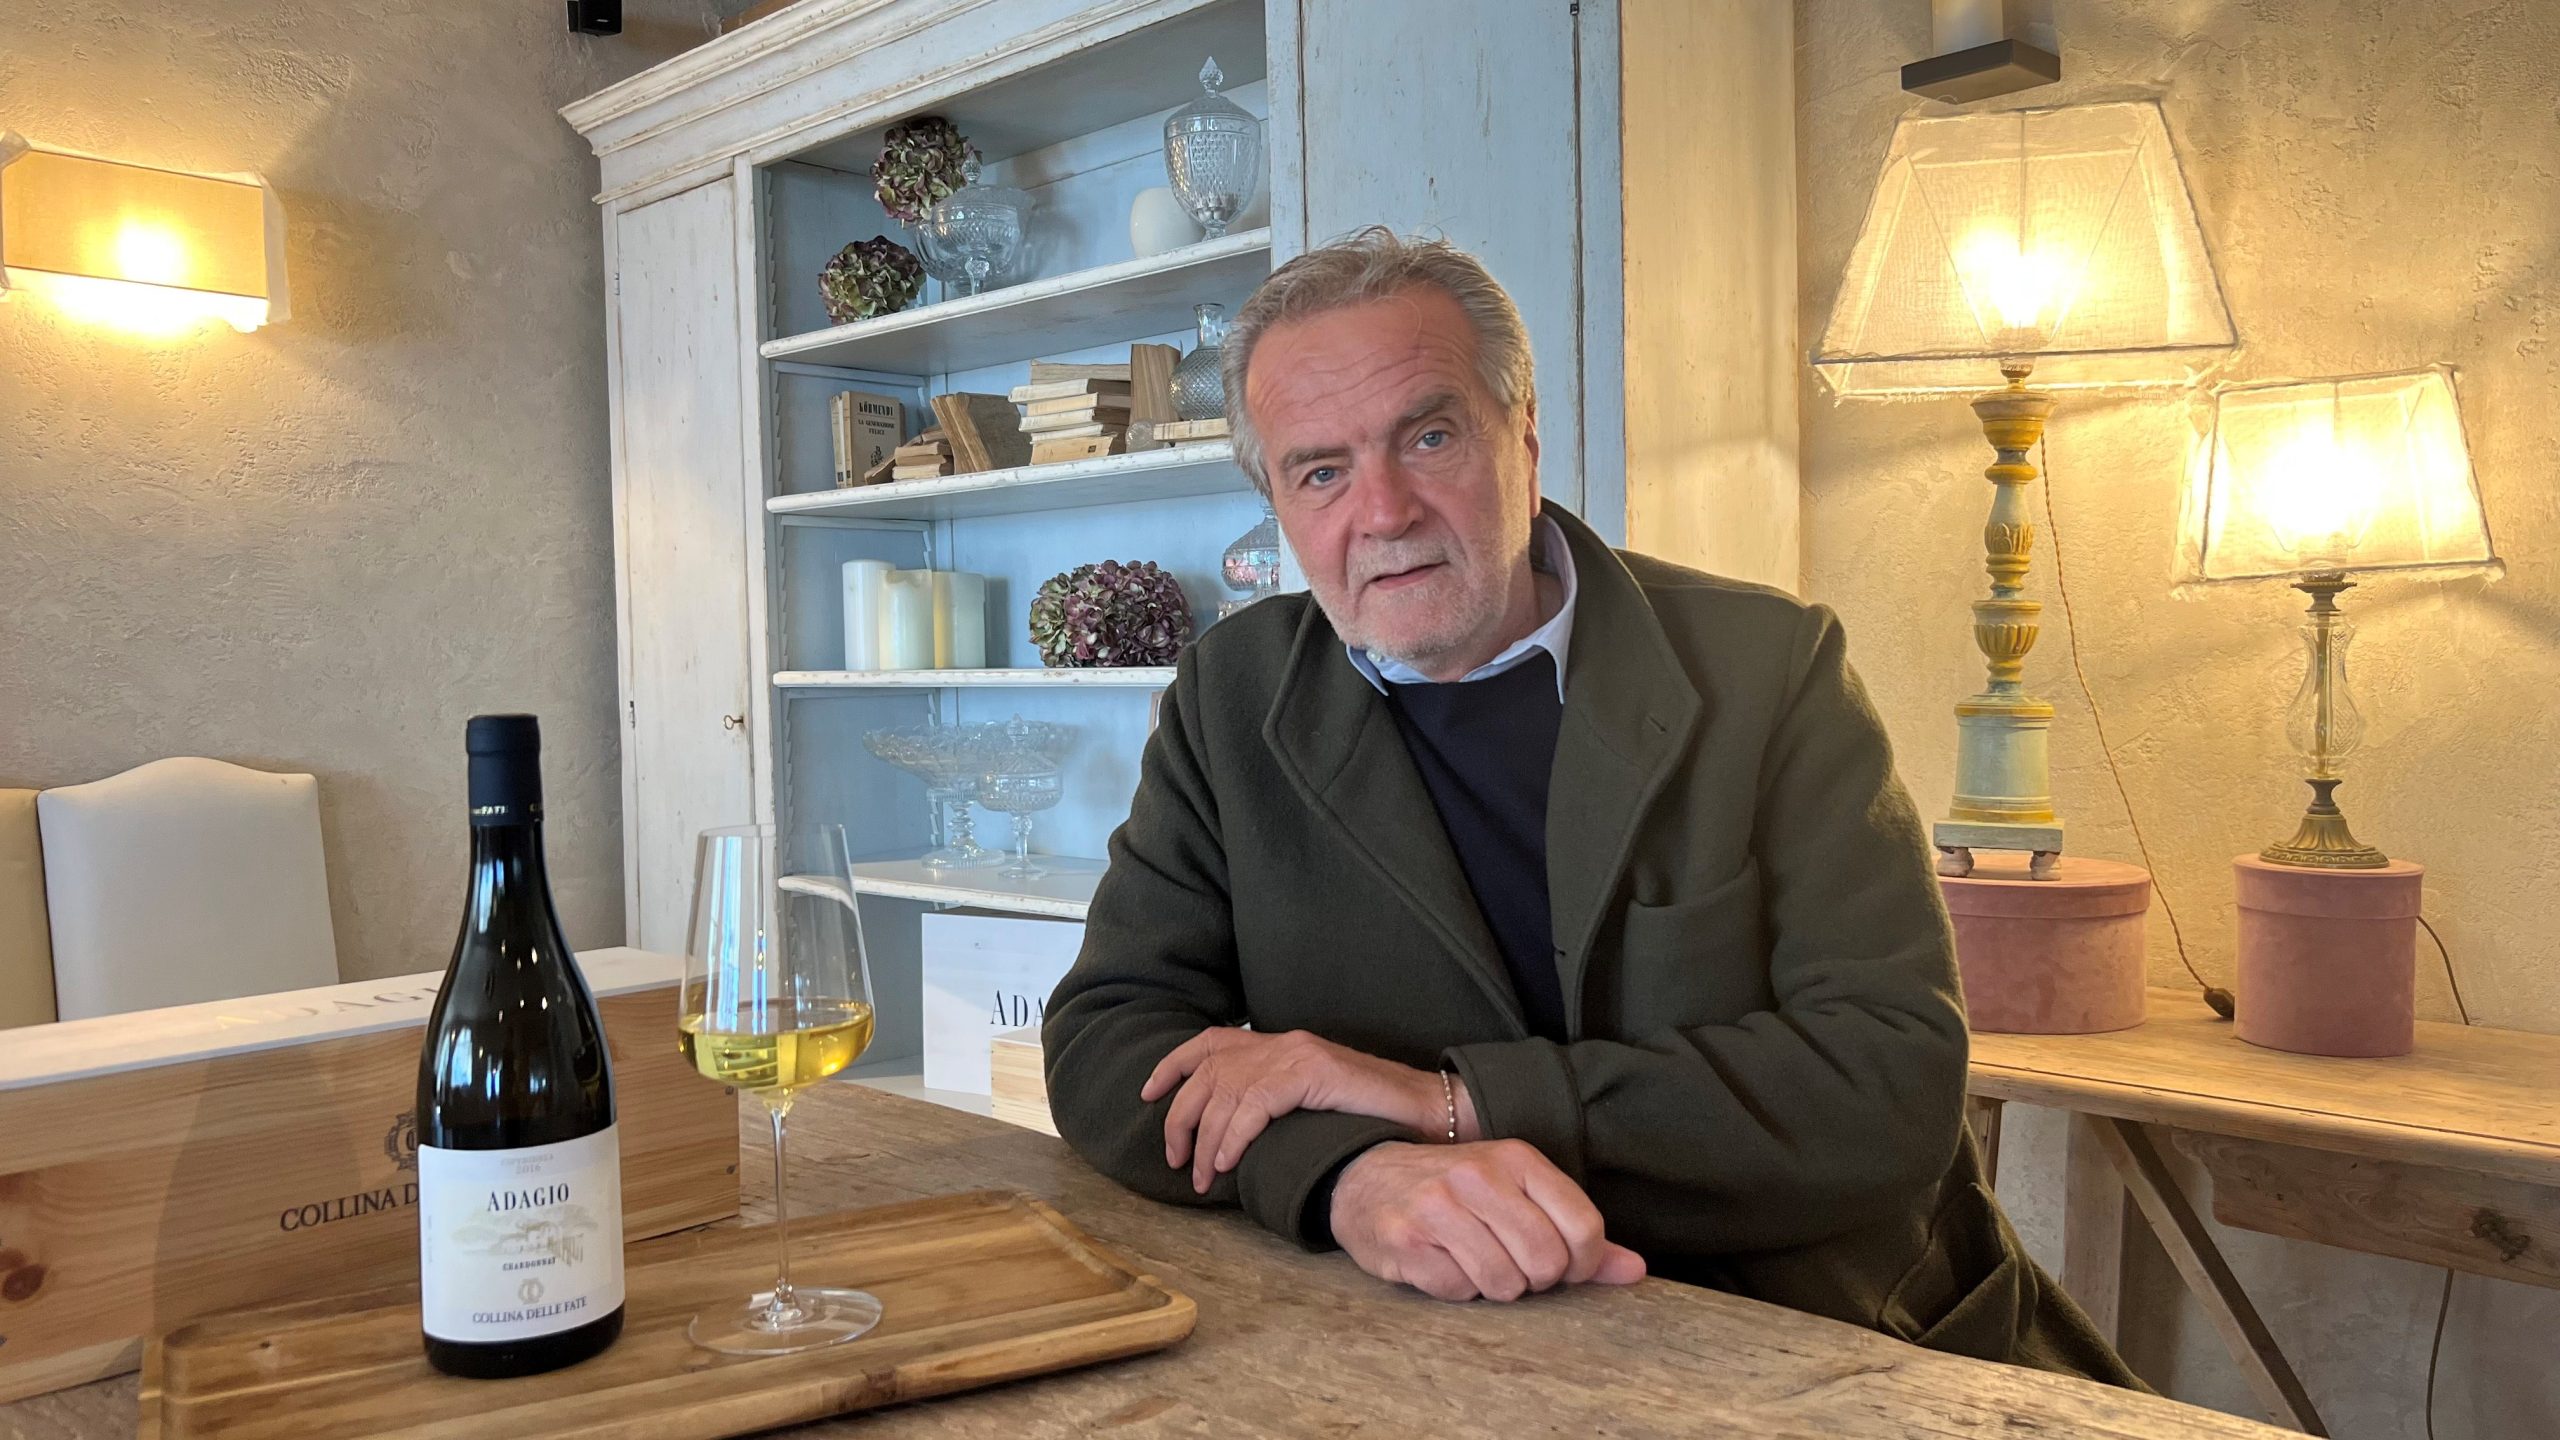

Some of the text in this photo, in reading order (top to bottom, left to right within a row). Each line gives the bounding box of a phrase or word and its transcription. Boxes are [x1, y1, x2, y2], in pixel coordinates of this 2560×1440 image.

[280, 1188, 397, 1231] COLLINA
[487, 1183, 569, 1212] ADAGIO
[472, 1296, 588, 1324] COLLINA DELLE FATE
